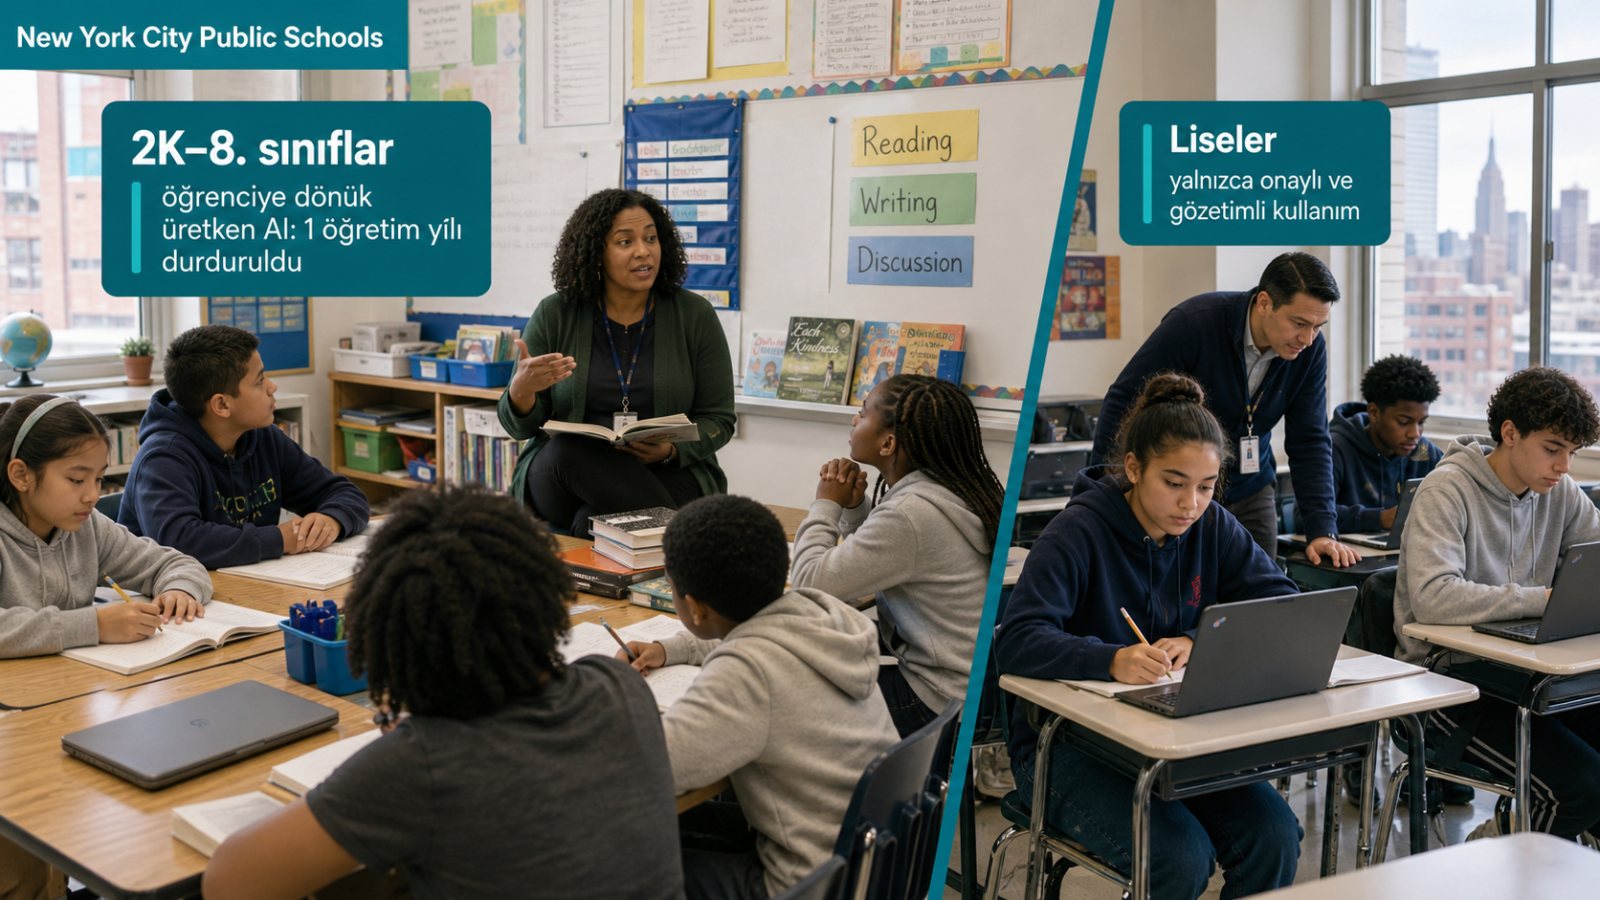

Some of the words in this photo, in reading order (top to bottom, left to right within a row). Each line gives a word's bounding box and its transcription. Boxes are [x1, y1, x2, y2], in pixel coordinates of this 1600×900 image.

[862, 126, 953, 162] Reading
[860, 187, 937, 224] Writing
[858, 246, 963, 273] Discussion
[791, 321, 822, 337] Each
[791, 338, 840, 354] Kindness
